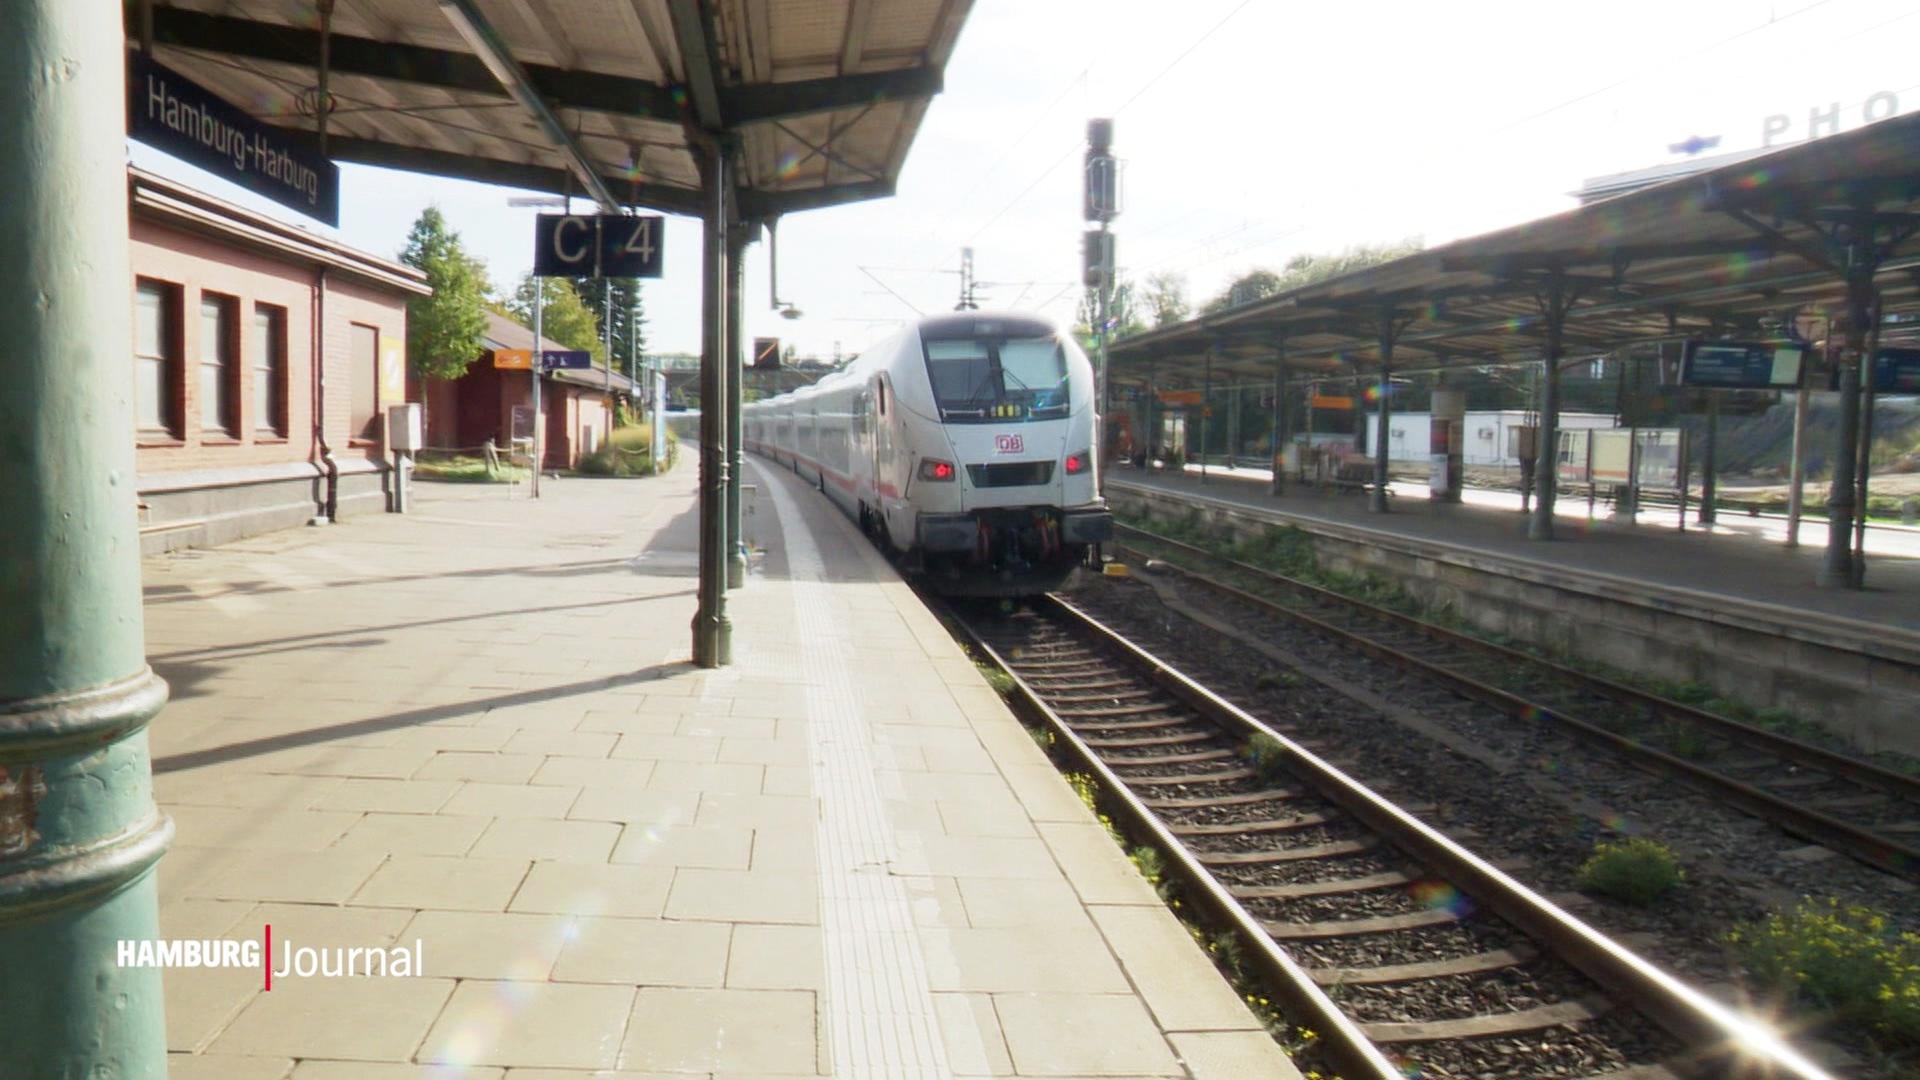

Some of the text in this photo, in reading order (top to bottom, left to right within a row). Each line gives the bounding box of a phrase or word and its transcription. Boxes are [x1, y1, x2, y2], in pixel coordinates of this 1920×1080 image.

[147, 74, 318, 206] Hamburg-Harburg
[553, 216, 588, 262] C
[625, 218, 655, 263] 4
[998, 436, 1021, 451] DB
